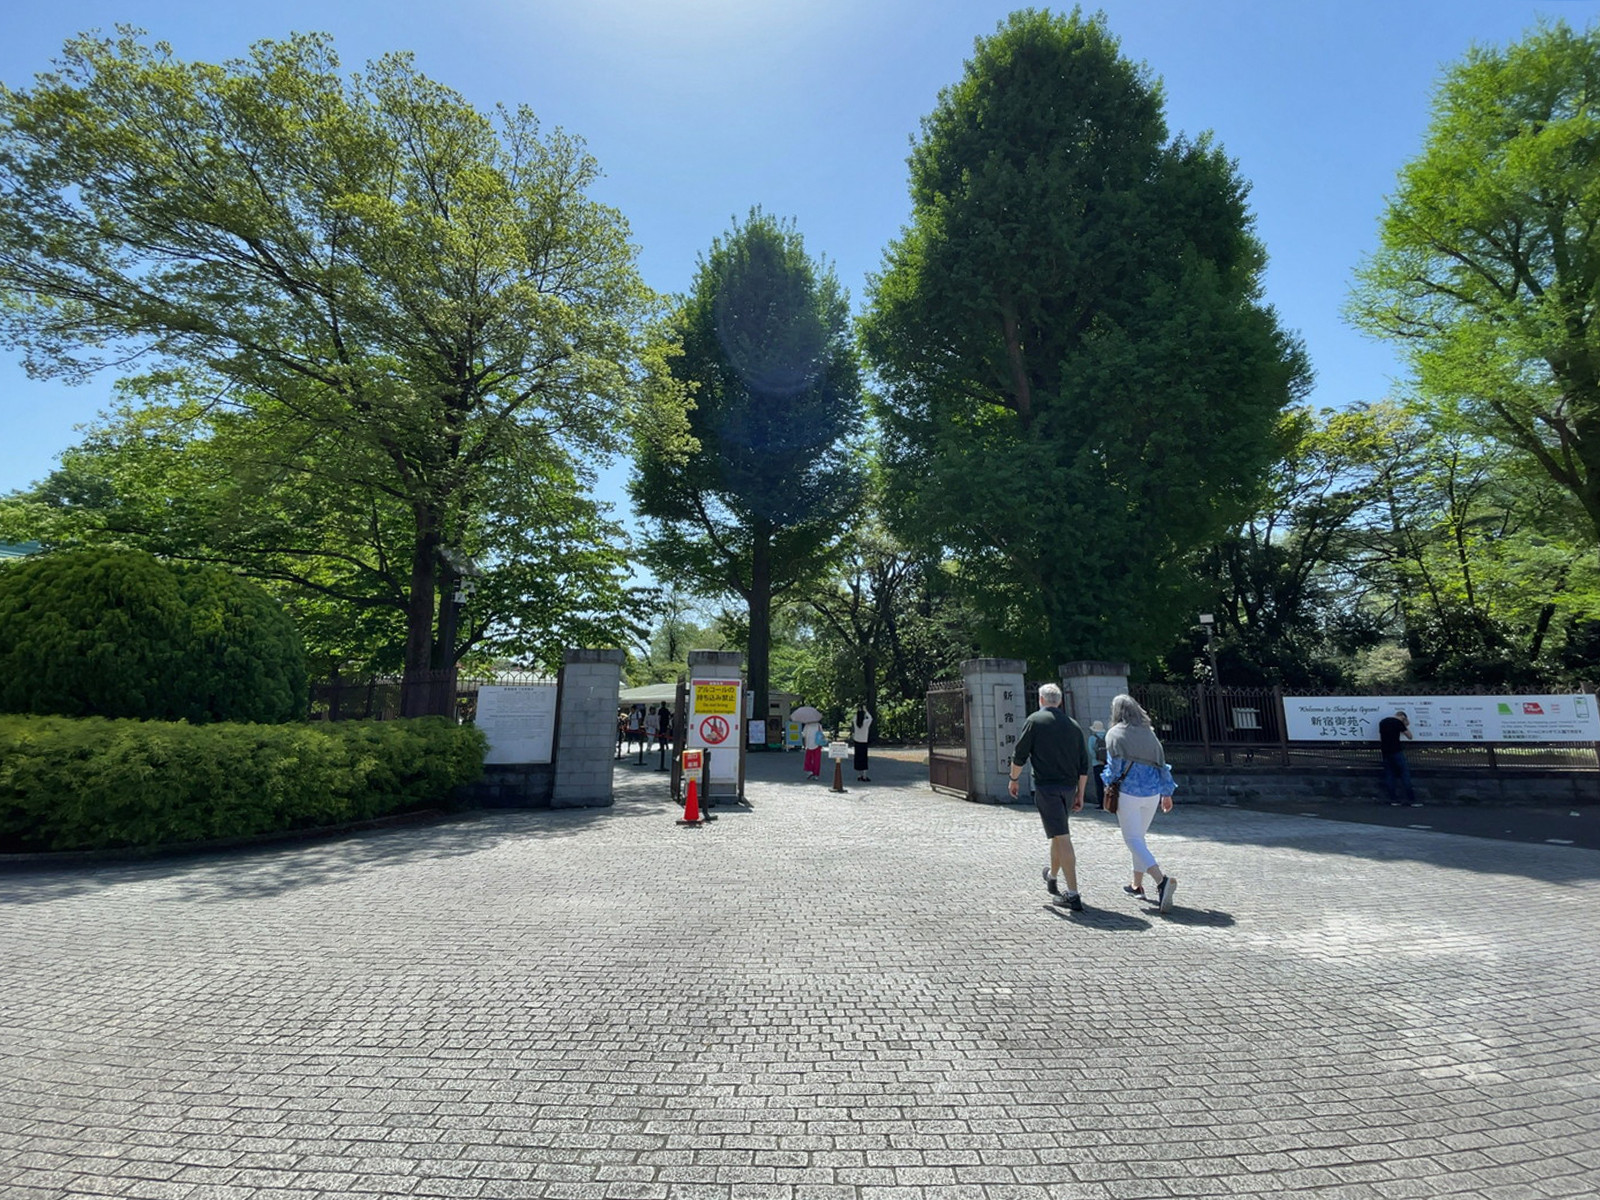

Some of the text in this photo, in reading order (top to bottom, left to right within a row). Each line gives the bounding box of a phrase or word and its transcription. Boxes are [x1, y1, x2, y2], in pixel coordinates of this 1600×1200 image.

[1333, 705, 1357, 715] Shinjuku
[1311, 716, 1370, 726] 新宿御苑へ
